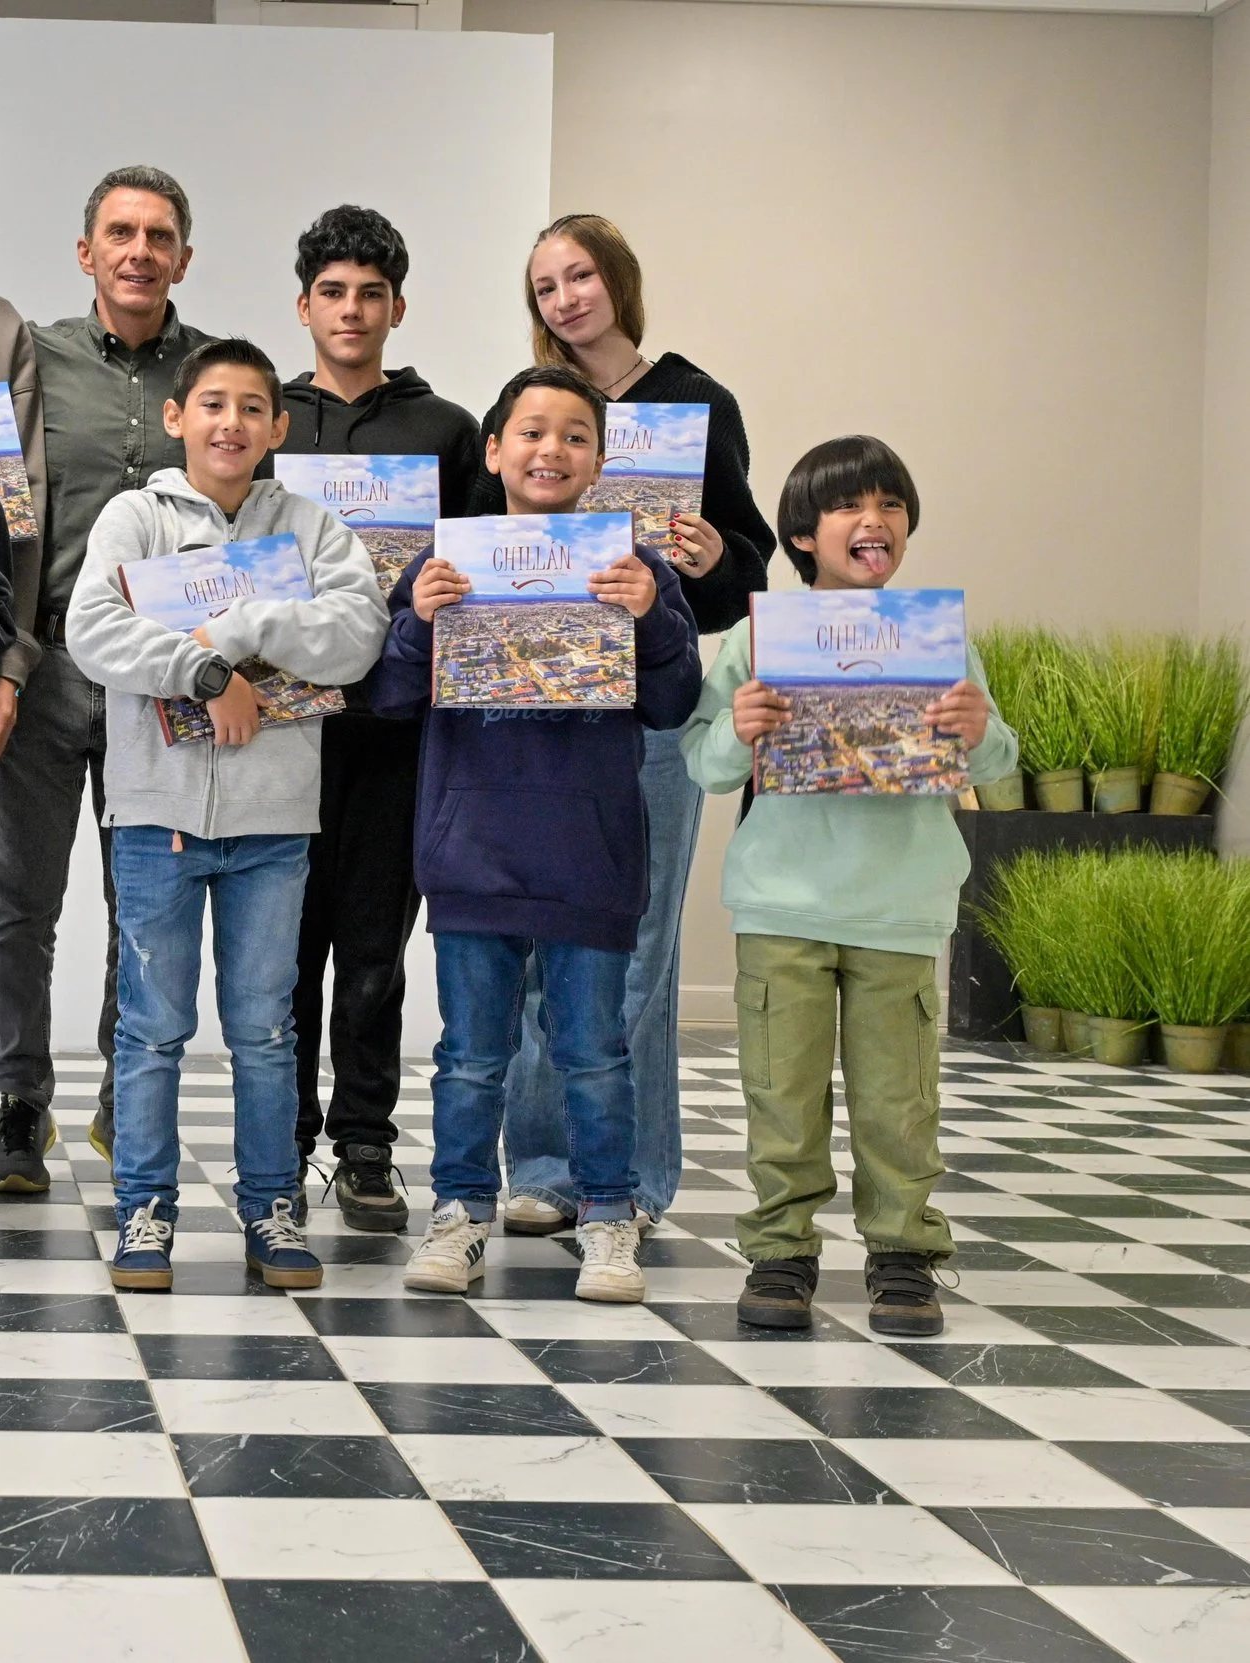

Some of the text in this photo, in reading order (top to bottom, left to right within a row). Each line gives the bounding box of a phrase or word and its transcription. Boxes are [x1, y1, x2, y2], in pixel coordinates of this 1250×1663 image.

[606, 425, 654, 450] ILLÁN
[323, 476, 389, 502] CHILLÁN
[492, 540, 572, 572] CHILLÁN
[184, 568, 256, 606] CHILLÁN
